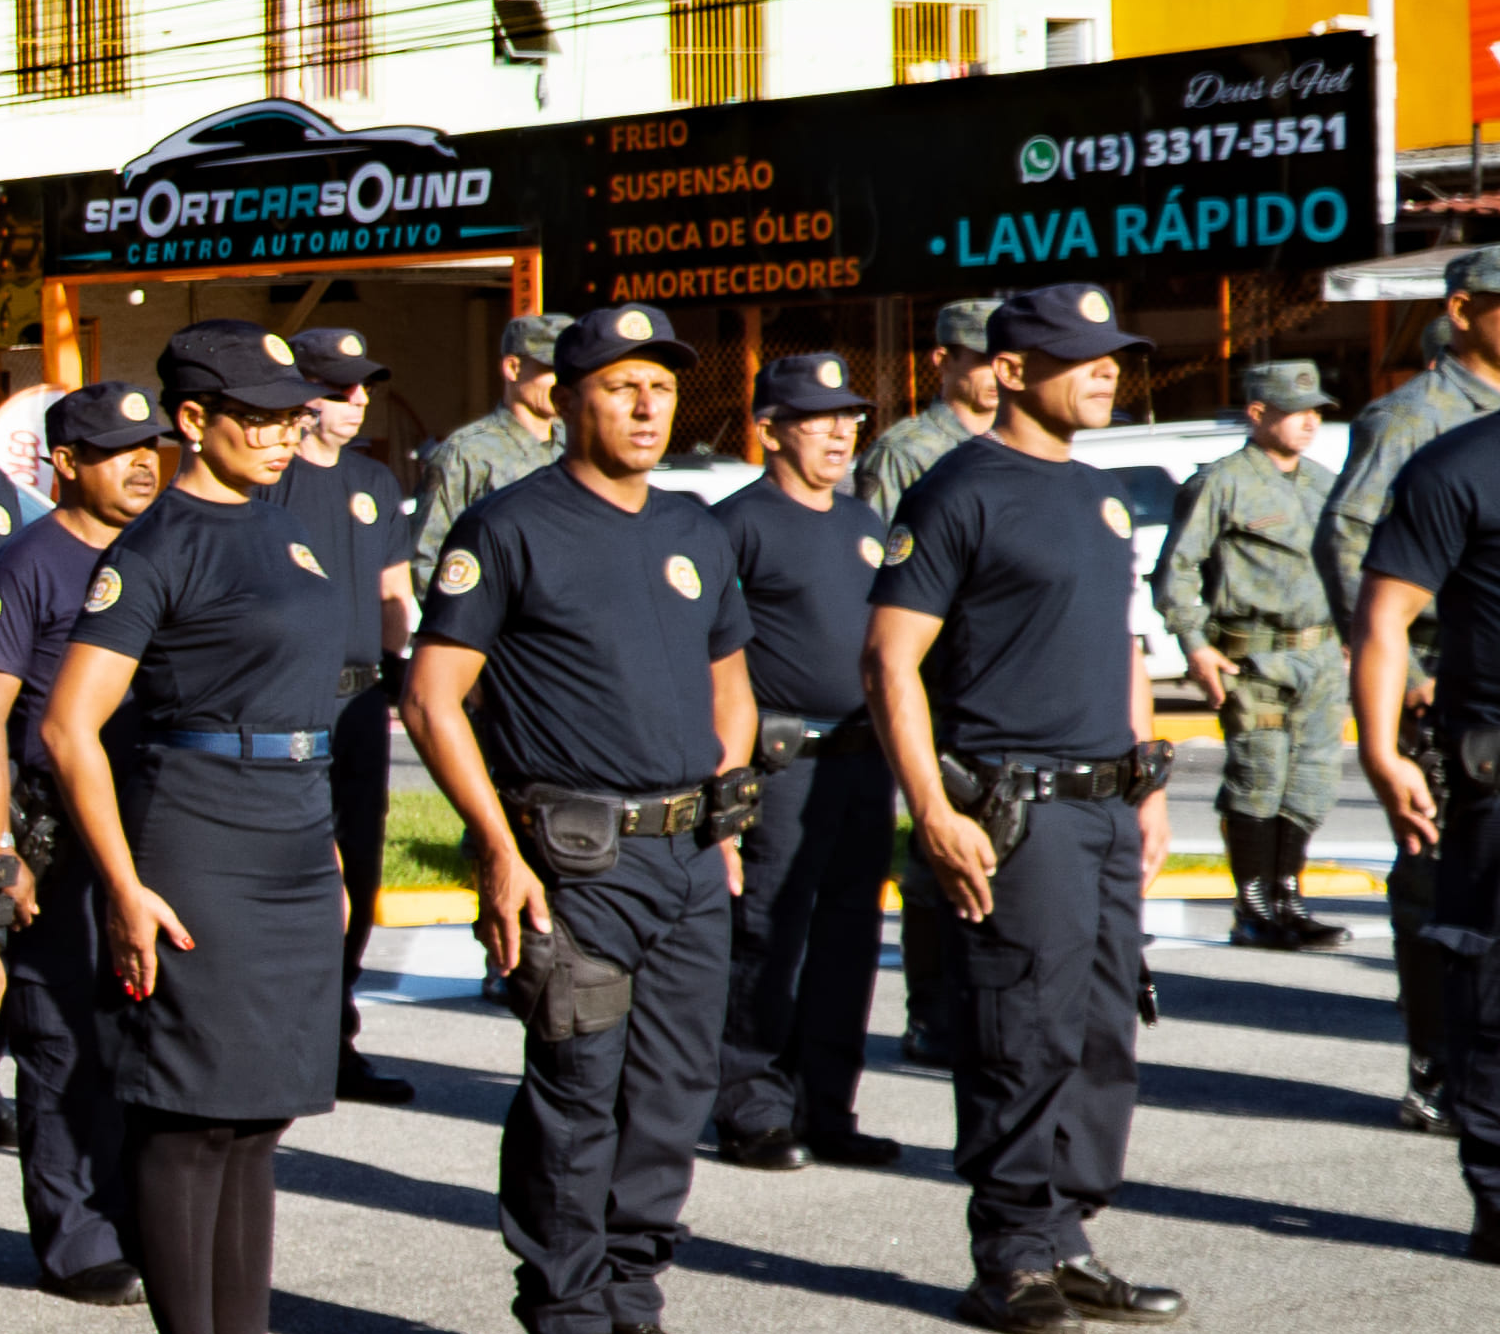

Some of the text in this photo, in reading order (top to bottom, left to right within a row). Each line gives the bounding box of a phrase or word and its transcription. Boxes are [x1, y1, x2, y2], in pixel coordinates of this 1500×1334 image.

[1183, 71, 1264, 108] Deus
[1290, 59, 1354, 100] Fiel
[610, 119, 689, 153] FREIO
[1061, 112, 1348, 181] (13) 3317-5521
[609, 156, 774, 203] SUSPENSÃO
[126, 222, 443, 265] CENTRO AUTOMOTIVO
[610, 208, 834, 256] TROCA DE ÓLEO
[958, 184, 1350, 268] LAVA RÁPIDO
[610, 257, 861, 302] AMORTECEDORES
